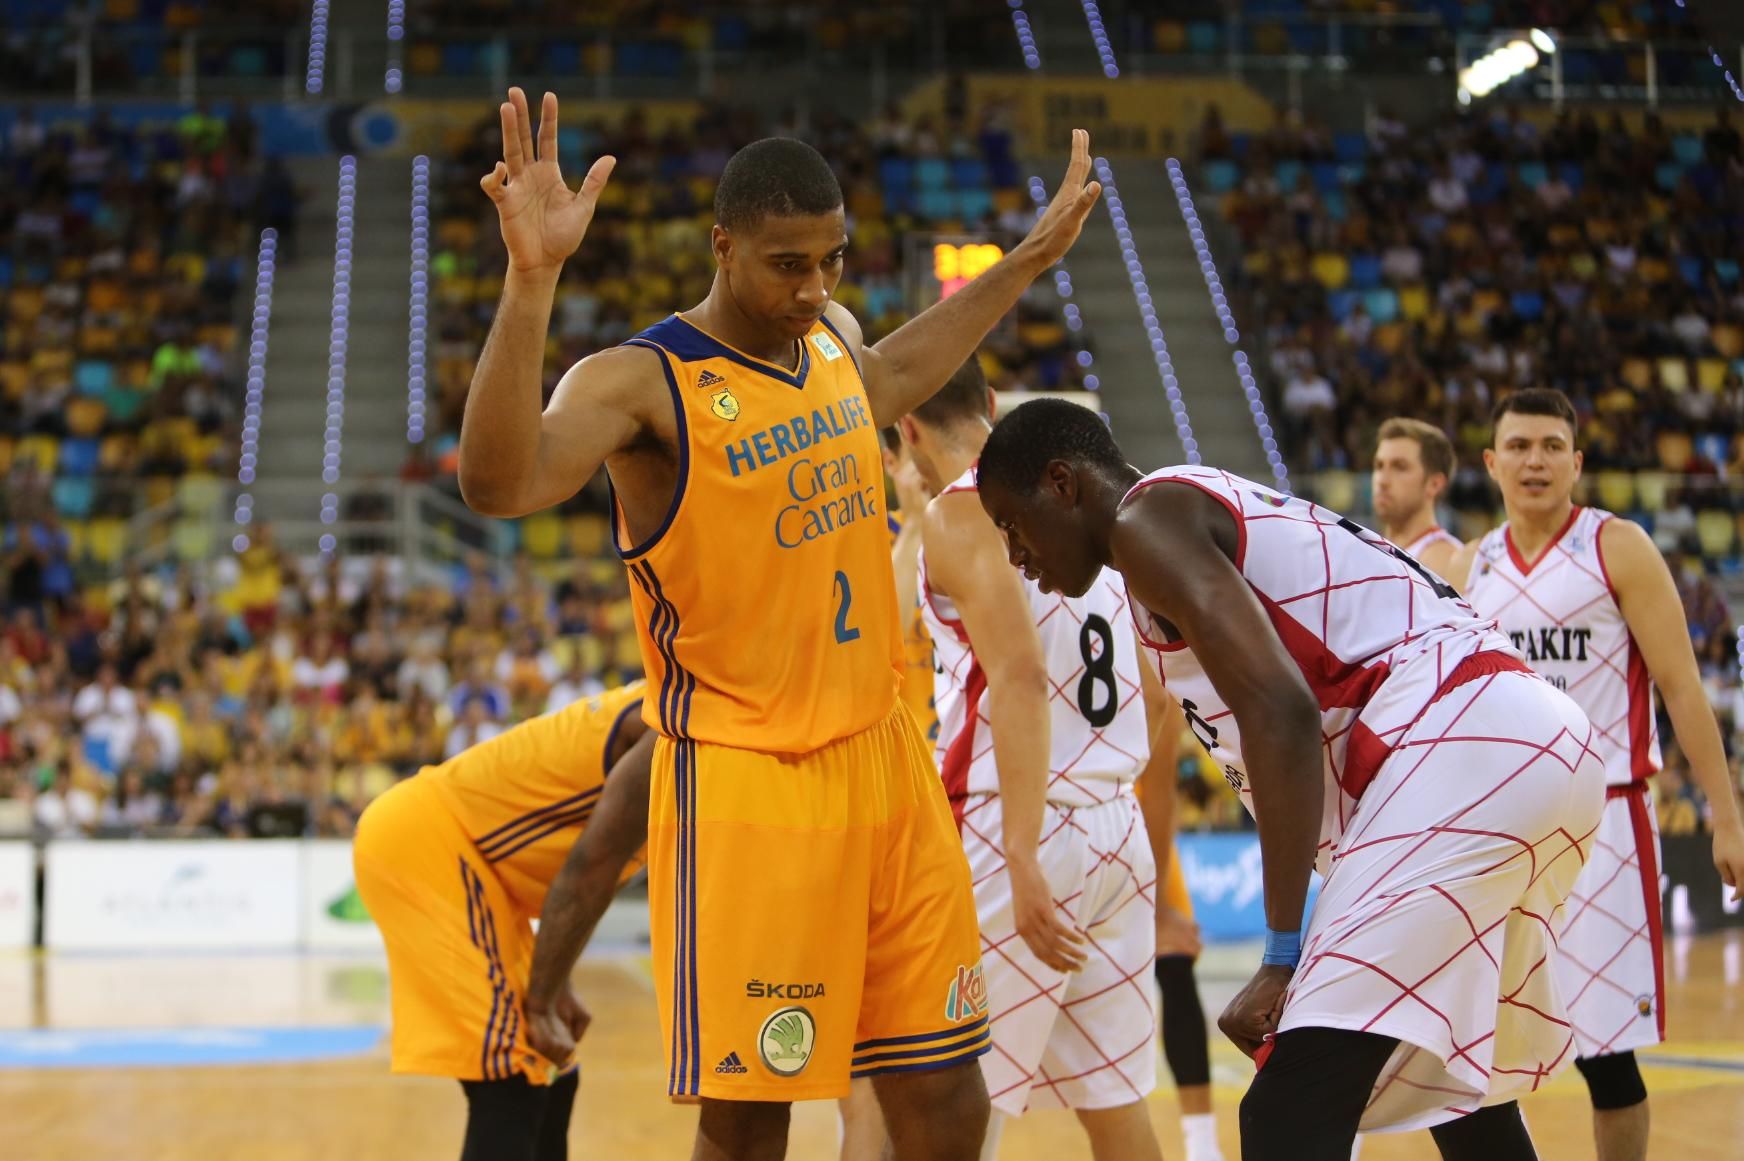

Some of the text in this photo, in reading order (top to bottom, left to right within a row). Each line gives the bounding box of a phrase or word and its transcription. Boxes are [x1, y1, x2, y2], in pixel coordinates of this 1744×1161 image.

[697, 376, 725, 389] adidas
[725, 396, 869, 477] HERBALIFE
[788, 453, 857, 502] Gran
[832, 570, 861, 645] 2
[1509, 628, 1592, 661] TAKIT
[1078, 613, 1119, 728] 8
[746, 979, 825, 1000] ŠKODA
[955, 966, 986, 1021] Kal
[715, 1065, 747, 1075] adidas
